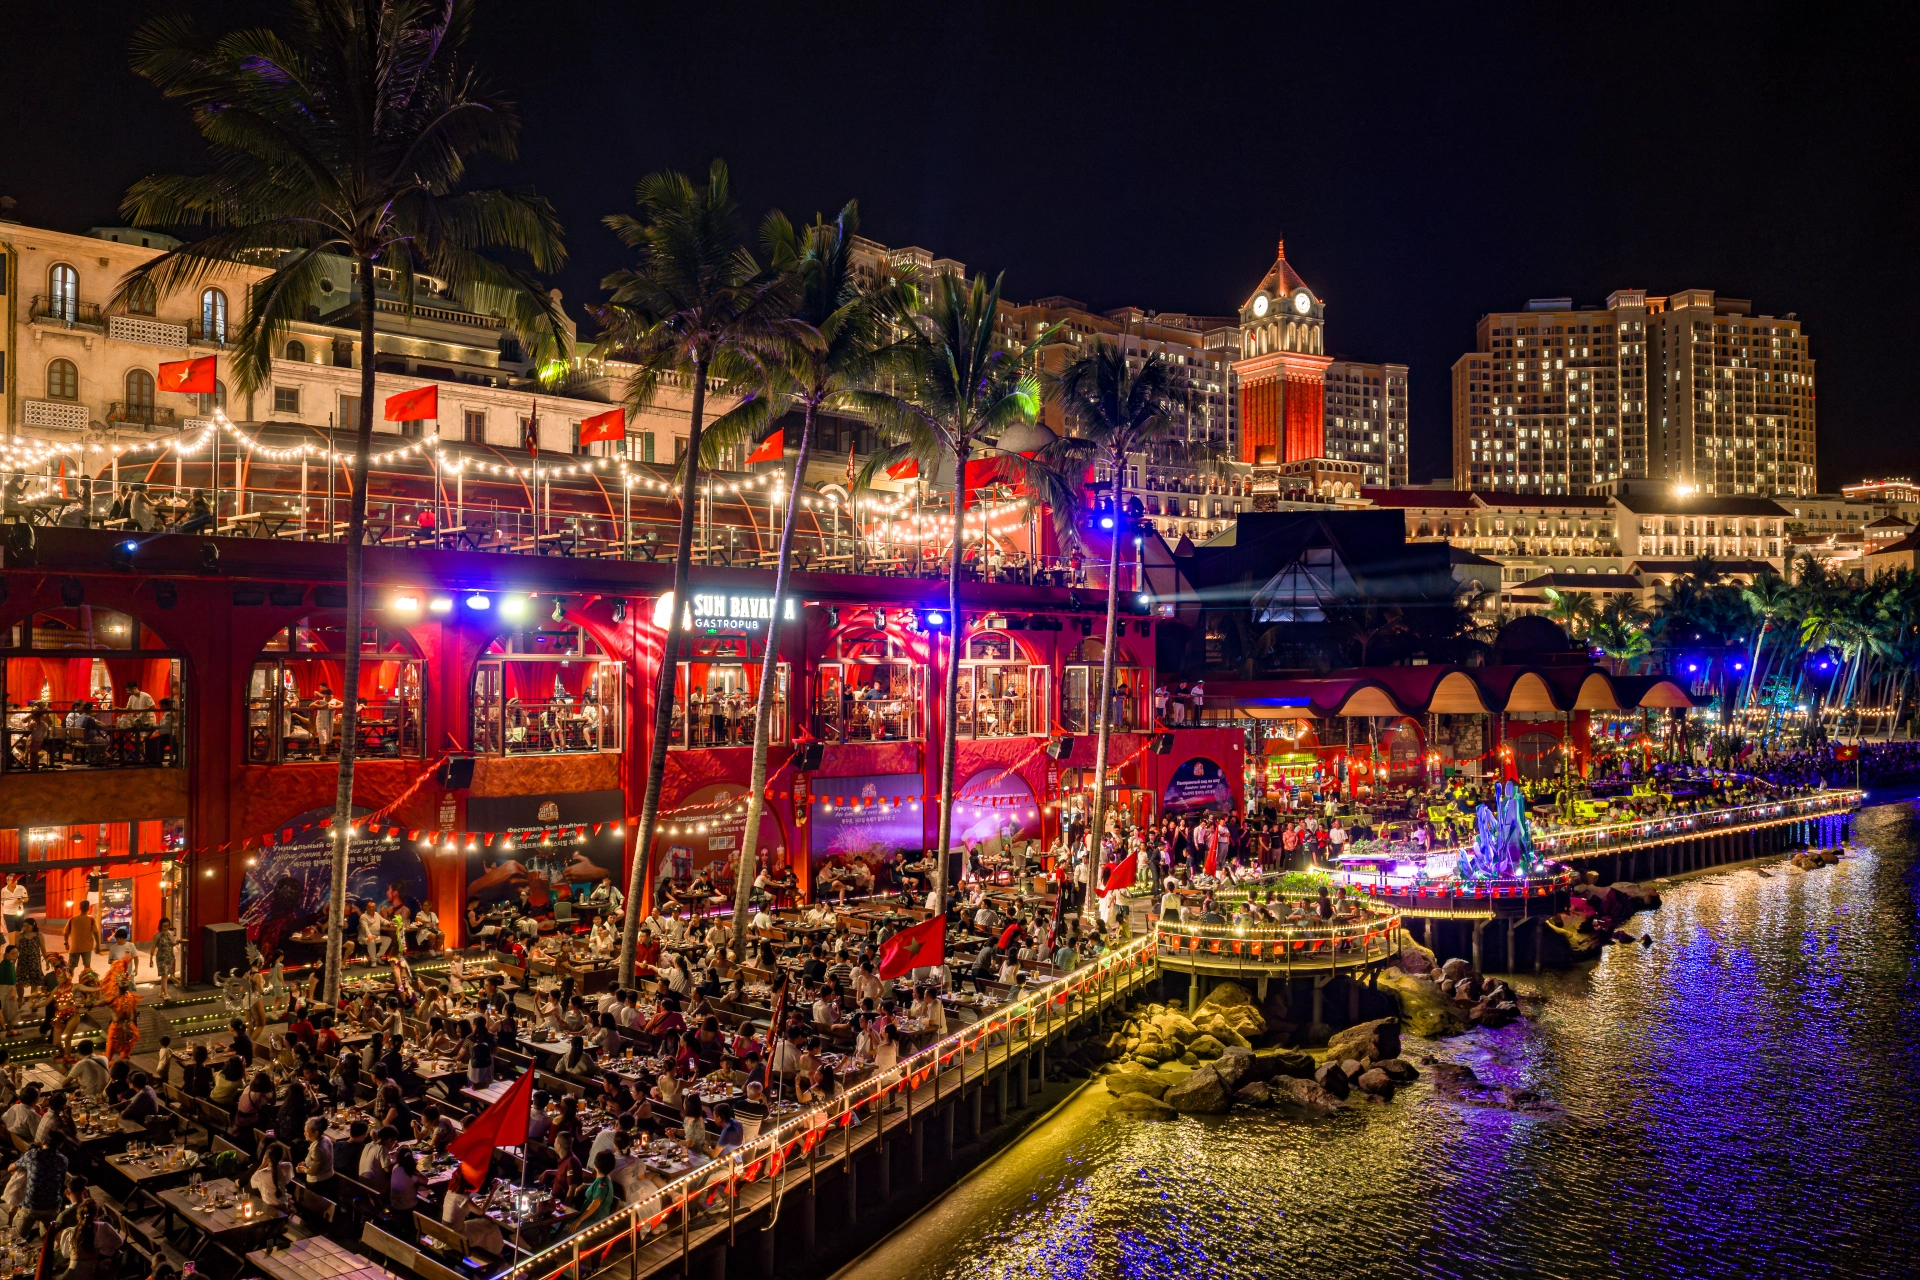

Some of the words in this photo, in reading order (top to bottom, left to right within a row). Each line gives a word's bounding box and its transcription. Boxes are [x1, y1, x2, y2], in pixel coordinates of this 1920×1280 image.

[694, 594, 726, 617] SUN
[730, 597, 795, 620] BAVAA
[695, 618, 759, 629] GASTROPUB
[272, 841, 324, 852] Уникльный
